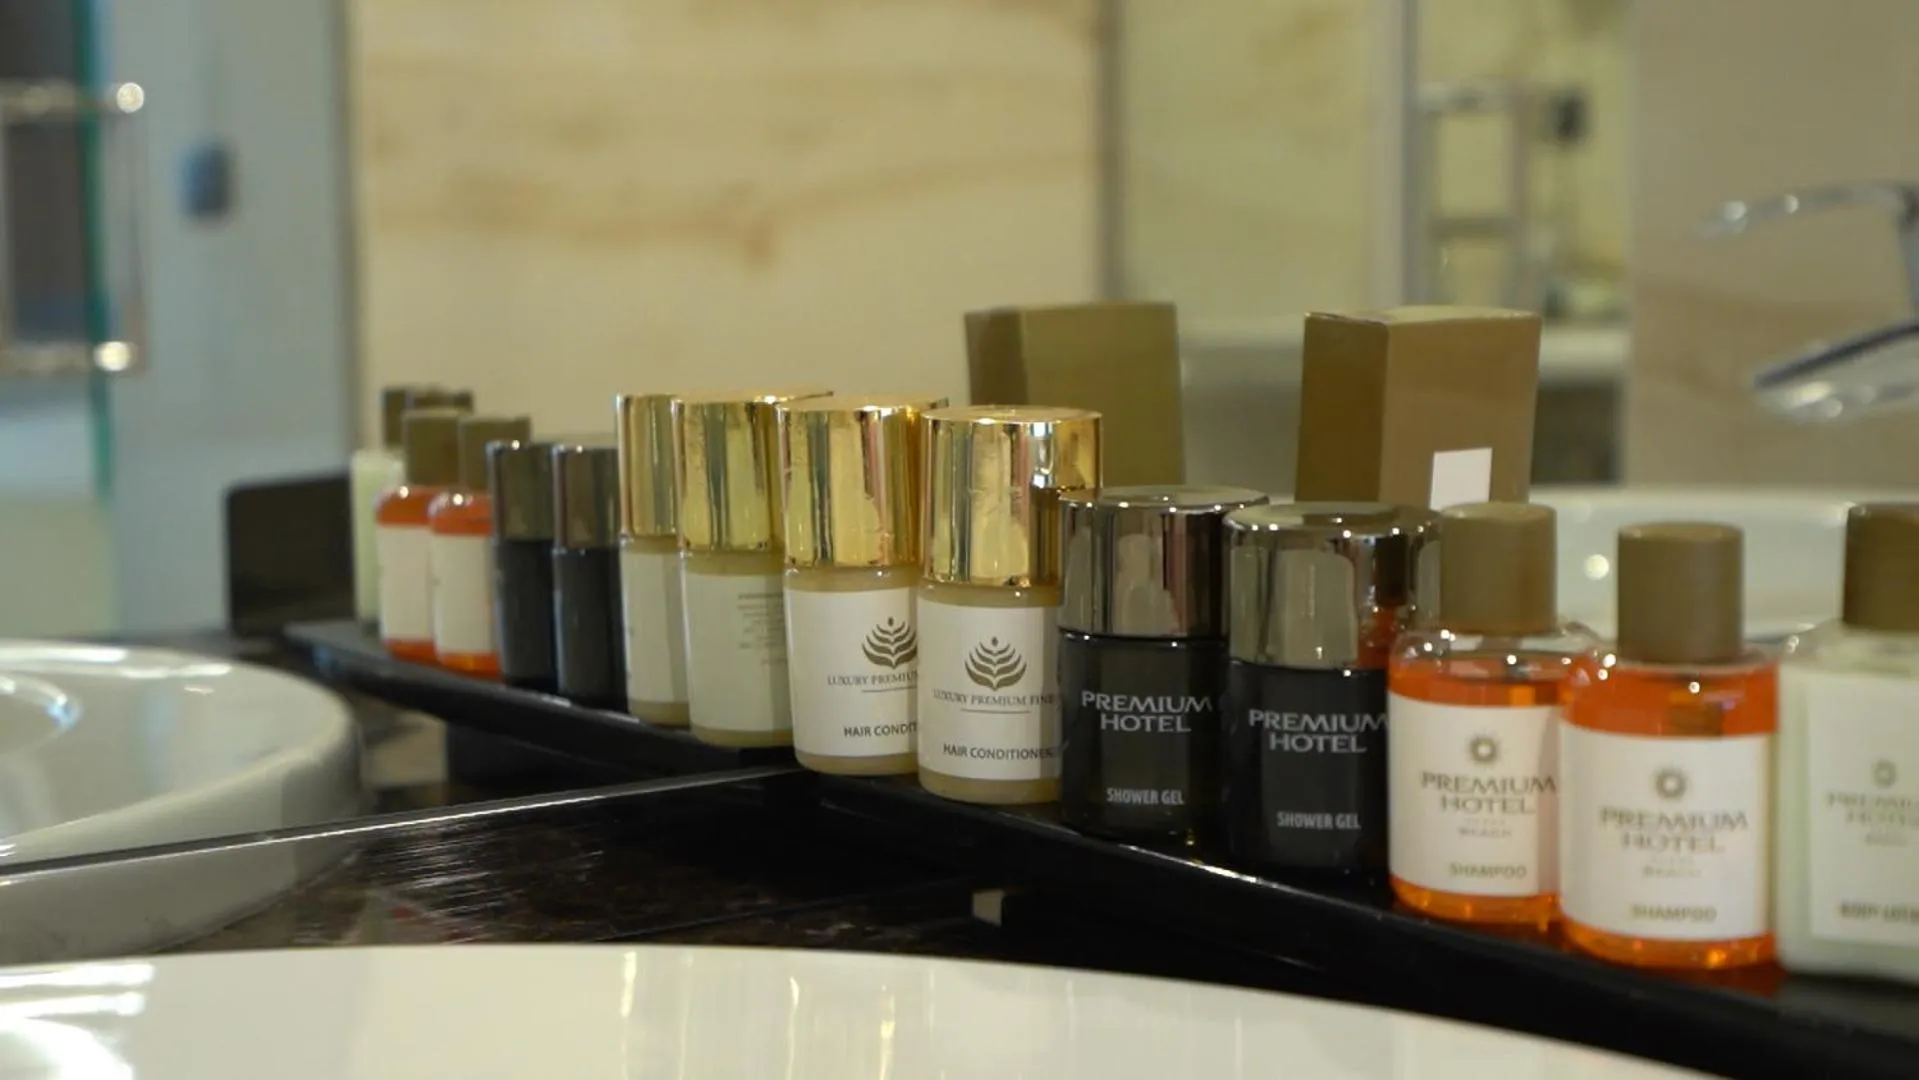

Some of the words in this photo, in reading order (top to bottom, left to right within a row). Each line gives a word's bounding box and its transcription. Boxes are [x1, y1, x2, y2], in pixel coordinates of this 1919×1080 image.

[827, 674, 868, 686] LUXURY
[871, 670, 918, 685] PREMIU
[933, 688, 969, 705] LUXURY
[971, 692, 1026, 706] PREMIUM
[1082, 690, 1213, 712] PREMIUM
[844, 724, 872, 738] HAIR
[874, 720, 918, 737] CONDIT
[1100, 713, 1192, 733] HOTEL
[1249, 709, 1388, 732] PREMIUM
[943, 743, 968, 758] HAIR
[1268, 733, 1367, 753] HOTEL
[1420, 771, 1557, 794] PREMIUM
[1107, 787, 1158, 805] SHOWER
[1161, 789, 1184, 805] GEL
[1440, 795, 1536, 815] HOTEL
[1277, 811, 1333, 829] SHOWER
[1336, 813, 1361, 830] GEL
[1599, 806, 1748, 832] PREMIUM
[1621, 831, 1726, 854] HOTEL
[1450, 861, 1528, 879] SHAMPOO
[1630, 903, 1717, 922] SHAMPOO
